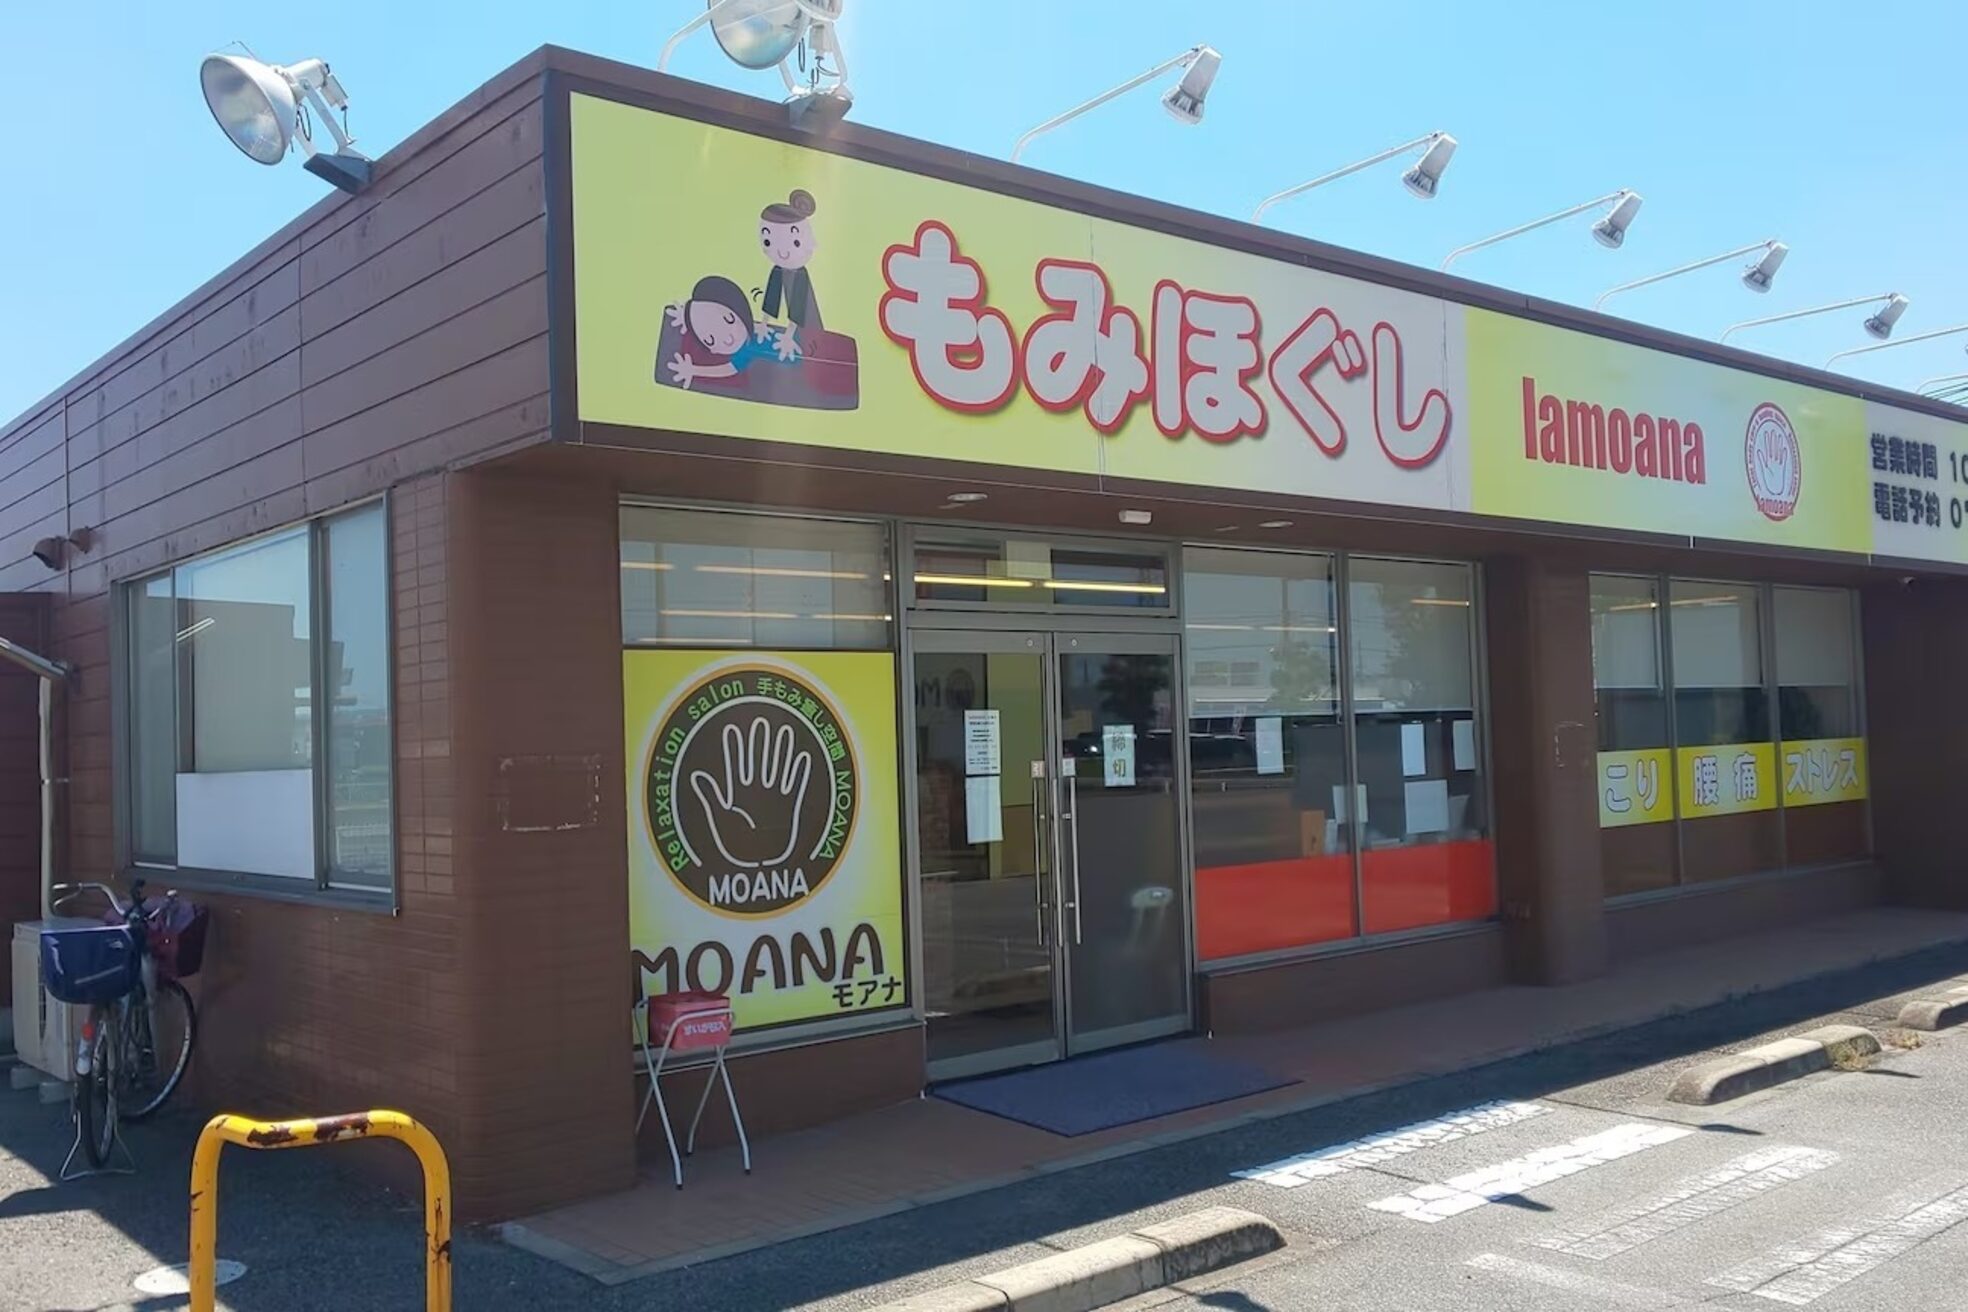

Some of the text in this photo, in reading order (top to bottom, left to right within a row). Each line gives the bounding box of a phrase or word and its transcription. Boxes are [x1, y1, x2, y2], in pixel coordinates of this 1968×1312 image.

[879, 220, 1453, 468] もみほぐし
[1522, 376, 1706, 485] lamoana
[1870, 433, 1938, 480] 営業時間
[1874, 482, 1940, 528] 電話予約
[654, 680, 744, 872] Relaxation salon
[1606, 758, 1658, 812] こり
[1693, 751, 1758, 806] 腰痛
[1786, 747, 1859, 795] ストレス
[819, 769, 852, 860] MOANA
[709, 868, 809, 906] MOANA
[632, 922, 885, 996] MOANA
[832, 976, 902, 1008] モアナ
